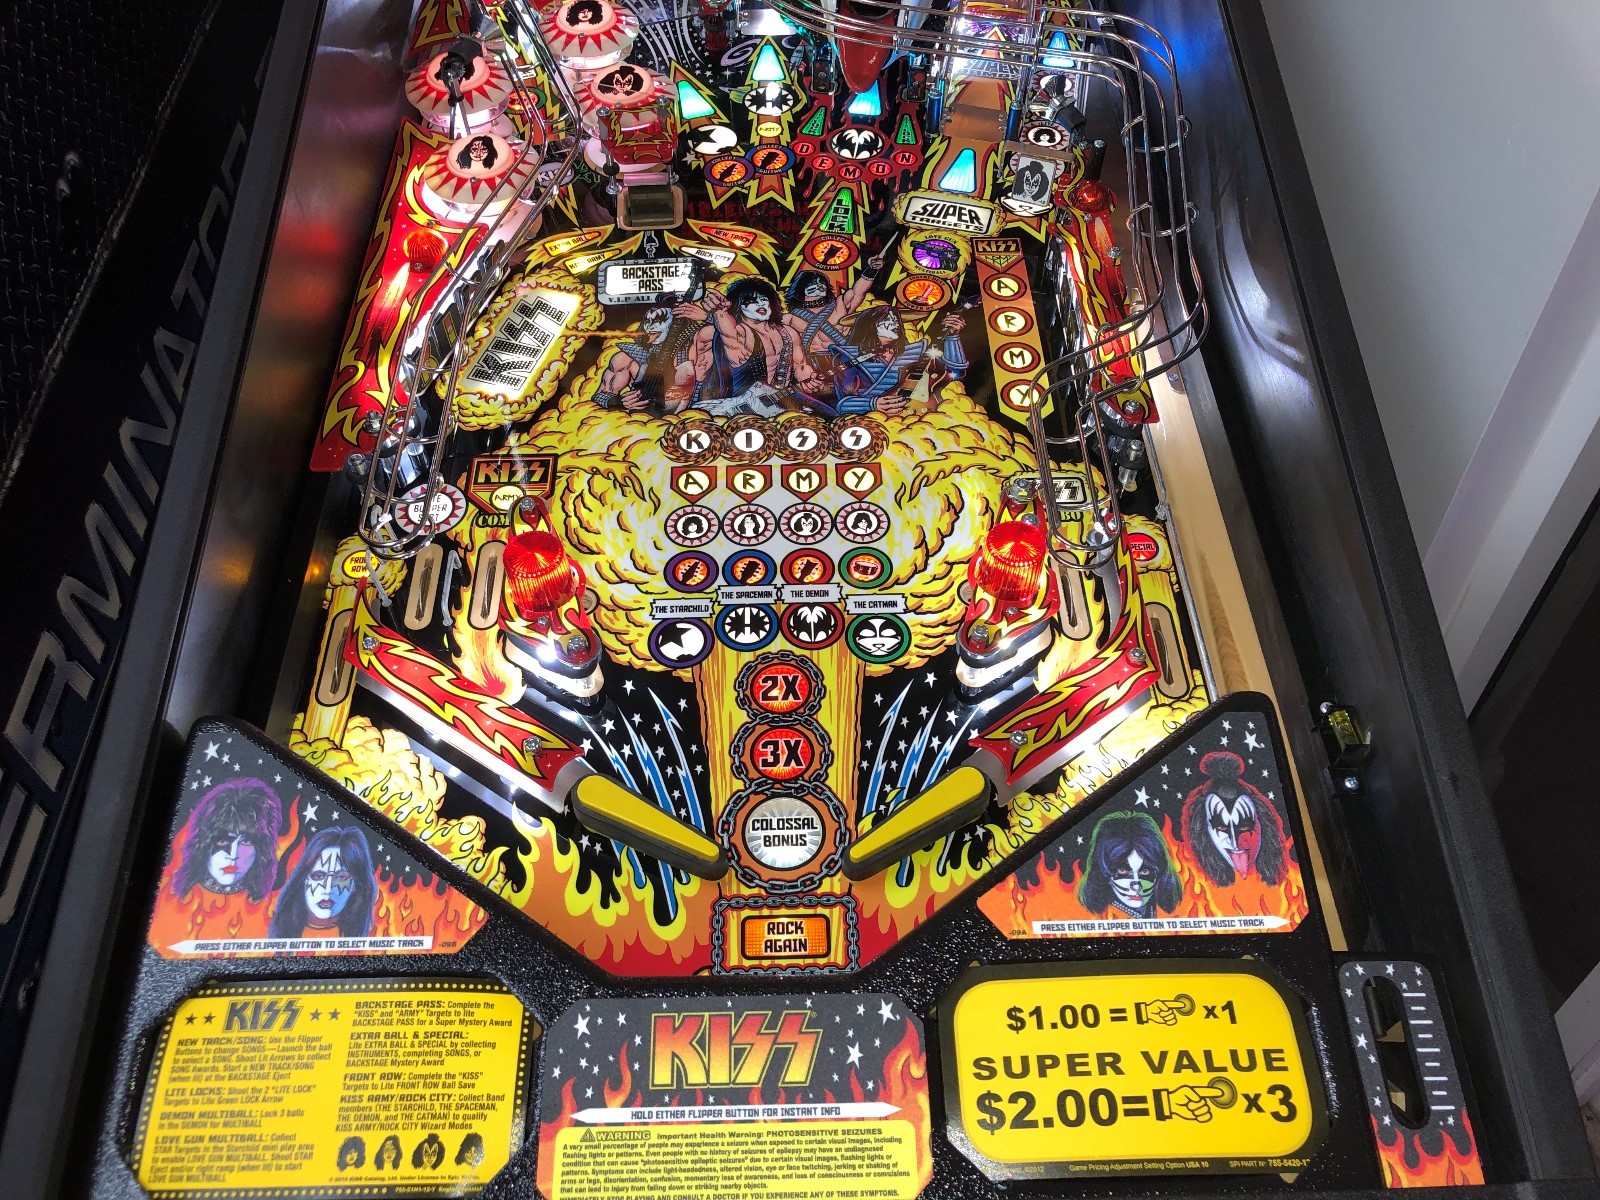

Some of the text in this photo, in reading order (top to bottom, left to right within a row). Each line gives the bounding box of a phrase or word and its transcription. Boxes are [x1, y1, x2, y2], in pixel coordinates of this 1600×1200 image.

[911, 202, 984, 226] SUPER
[910, 215, 984, 232] TARGETS
[713, 229, 728, 239] NEW
[978, 240, 1017, 252] KISS
[695, 249, 713, 259] ROCK
[621, 265, 680, 280] BACKSTAGE
[638, 278, 664, 292] PASS
[467, 296, 571, 391] KISS
[477, 461, 546, 483] KISS
[1129, 542, 1156, 551] PECIAL
[721, 590, 773, 599] THE SPACEMAN
[790, 590, 829, 598] THE DEMON
[655, 604, 710, 614] THE STARCHILD
[853, 600, 898, 609] THE CATMAN
[759, 673, 802, 703] 2X
[758, 738, 804, 769] 3X
[751, 816, 818, 832] COLOSSAL
[763, 833, 807, 847] BONUS
[767, 920, 804, 935] ROCK
[1040, 918, 1265, 932] PRESS EITHER FLIPPER BUTTON TO SELECT MUSIC TRACK
[194, 939, 424, 951] PRESS EITHER FLIPPER BUTTON TO SELECT MUSIC TRACK
[764, 938, 808, 953] AGAIN
[355, 1000, 495, 1010] BACKSTAGE PASS: Complete the
[223, 997, 303, 1033] KISS
[380, 1009, 394, 1017] and
[426, 1009, 452, 1018] Targets
[454, 1009, 461, 1017] to
[463, 1009, 475, 1017] lite
[1006, 1003, 1101, 1034] $1.00
[1203, 1000, 1238, 1026] x1
[352, 1018, 394, 1026] BACKSTAGE
[396, 1018, 415, 1026] PASS
[416, 1018, 427, 1026] for
[435, 1018, 457, 1027] Super
[458, 1018, 487, 1027] Mystery
[489, 1018, 513, 1027] Award
[177, 1035, 267, 1046] NEW TRACK/SONG:
[350, 1030, 469, 1040] EXTRA BALL & SPECIAL:
[650, 1010, 823, 1090] KISS
[972, 1048, 1290, 1081] SUPER VALUE
[343, 1072, 376, 1081] FRONT
[380, 1071, 407, 1081] ROW:
[408, 1072, 443, 1081] Complete
[444, 1072, 457, 1080] the
[165, 1086, 226, 1097] LITE LOCKS:
[340, 1093, 505, 1103] KISS ARMY/ROCK CITY: Collect Band
[1243, 1083, 1298, 1124] x3
[160, 1109, 259, 1120] DEMON MULTIBALL:
[631, 1106, 841, 1120] HOLD EITHER FLIPPER BUTTON FOR INSTANT INFO
[155, 1135, 181, 1144] LOVE
[209, 1133, 269, 1143] MULTIBALL:
[596, 1128, 883, 1142] WARNING Important Health Warning: PHOTOSENSITIVE SEIZURES
[1110, 1163, 1142, 1171] Adjustment
[1165, 1161, 1185, 1169] Option
